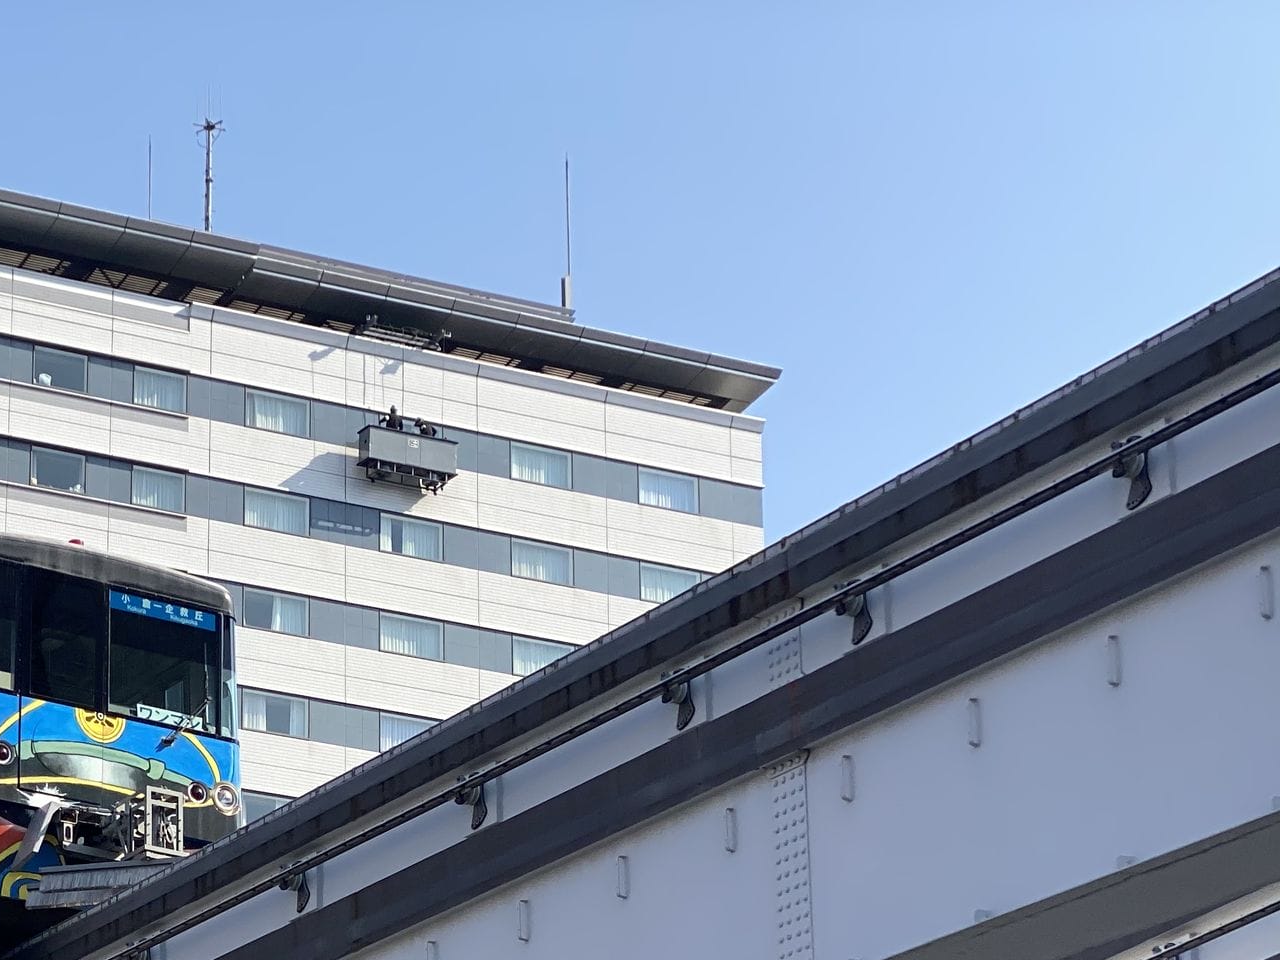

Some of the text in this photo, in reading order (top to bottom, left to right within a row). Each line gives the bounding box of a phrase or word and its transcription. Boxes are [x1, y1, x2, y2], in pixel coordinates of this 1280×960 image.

[126, 604, 147, 615] Kokura
[140, 707, 201, 728] ワンマン
